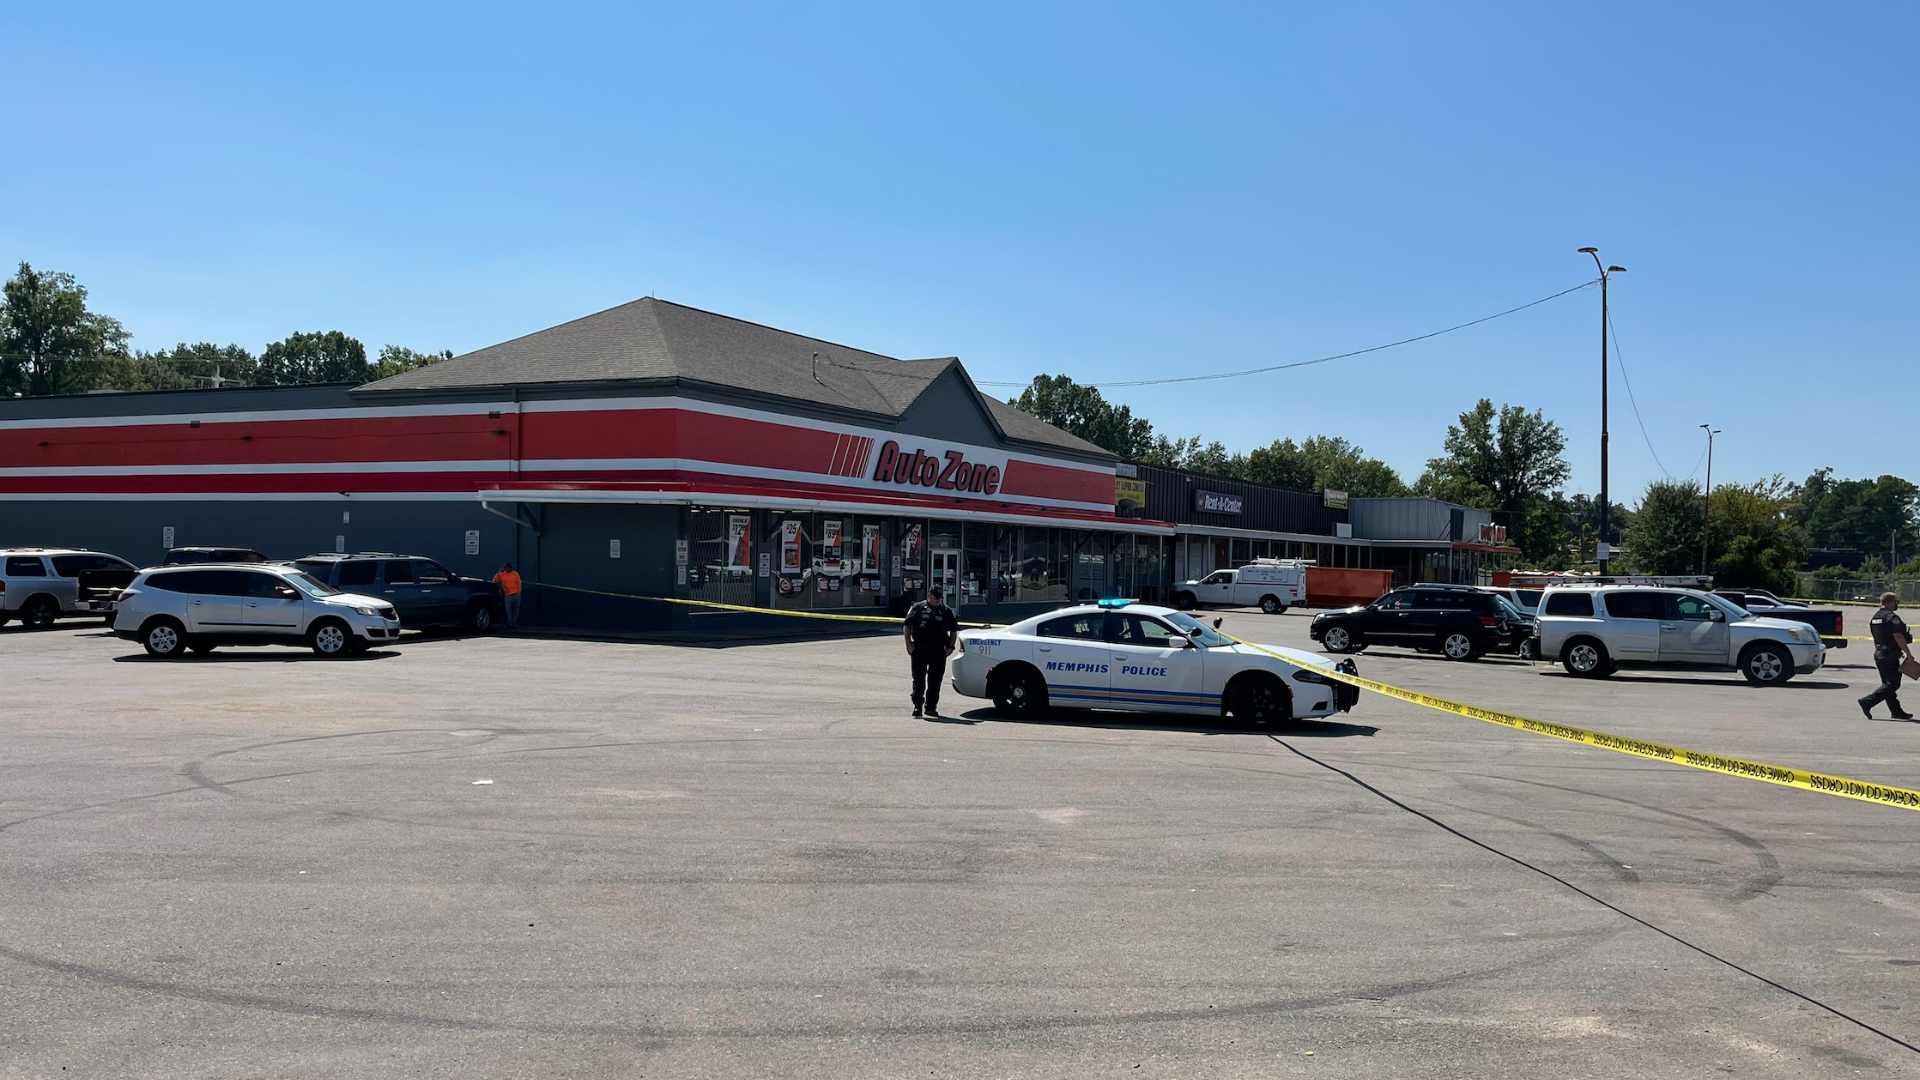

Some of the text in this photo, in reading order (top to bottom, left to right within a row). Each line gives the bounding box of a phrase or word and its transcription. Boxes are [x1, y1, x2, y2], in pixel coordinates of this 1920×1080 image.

[873, 440, 1000, 495] AutoZone
[1204, 495, 1242, 513] Rent-A-Center
[786, 523, 797, 535] $25
[978, 645, 991, 655] 911
[1045, 661, 1168, 677] MEMPHIS POLICE
[1593, 733, 1675, 760] CRIME SCENE DO NOT CROSS
[1686, 751, 1795, 783] CRIME SCENE DO NOT CROSS
[1810, 774, 1919, 806] SCENE DO NOT CROSS
